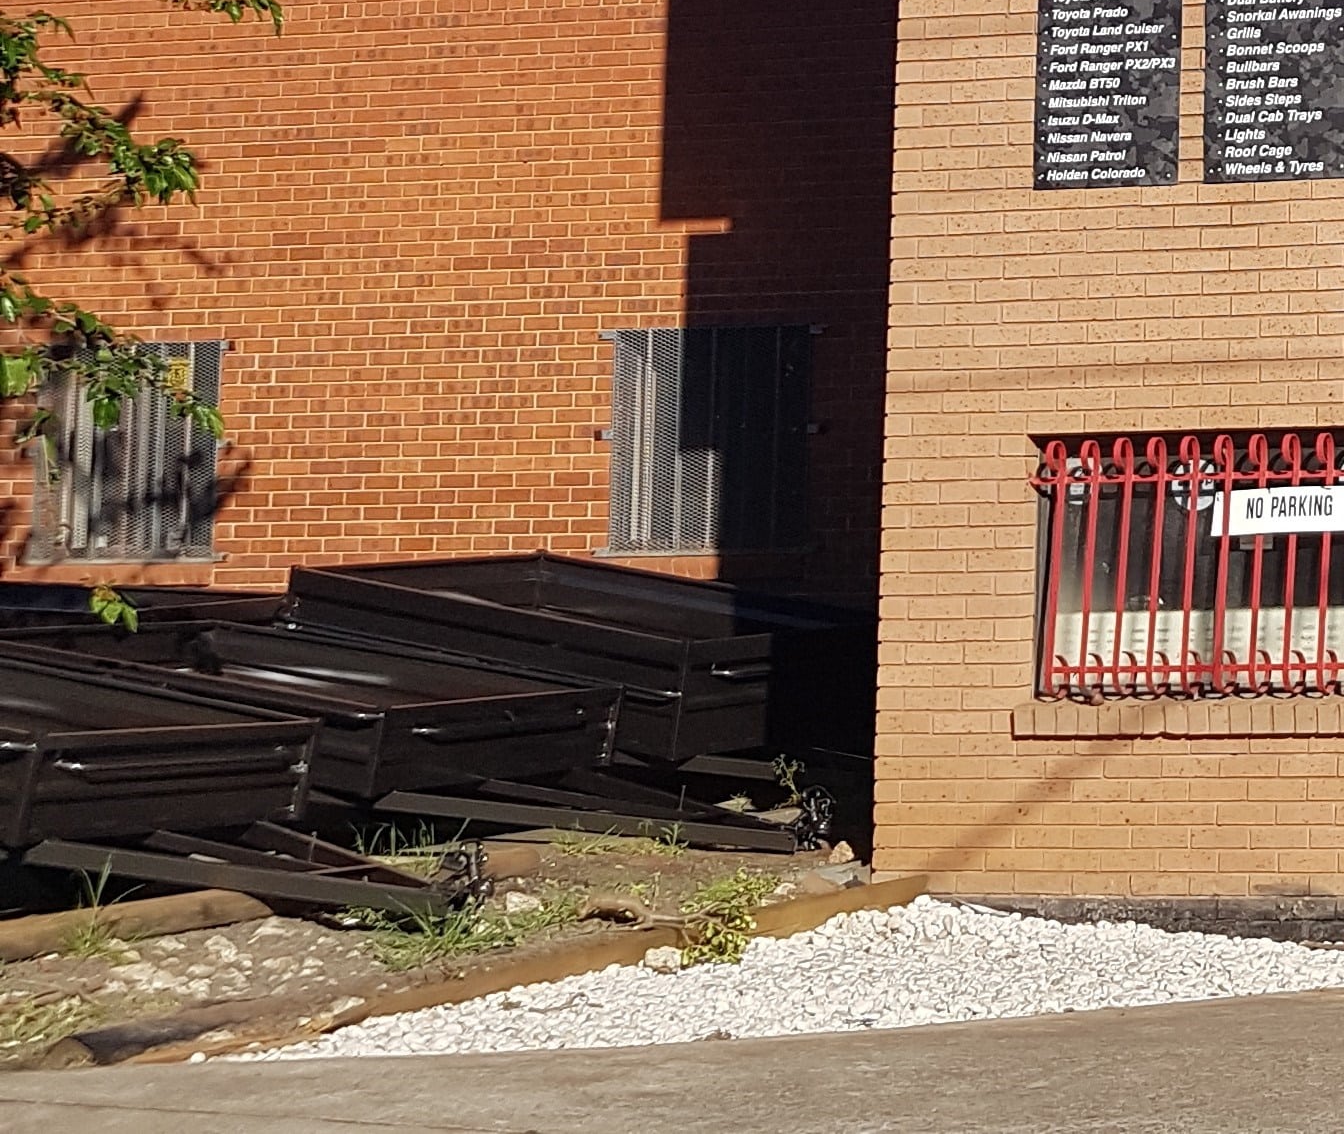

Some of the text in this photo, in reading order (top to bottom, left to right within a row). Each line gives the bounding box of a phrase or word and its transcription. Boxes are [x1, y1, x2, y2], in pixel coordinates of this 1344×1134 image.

[1052, 7, 1128, 22] Toyota Prado
[1278, 7, 1342, 21] Awanings
[1051, 26, 1090, 40] Toyota
[1093, 24, 1122, 36] Land
[1226, 27, 1261, 39] Grills
[1050, 41, 1149, 56] Ford Ranger PX1
[1226, 42, 1325, 56] Bonnet Scoops
[1049, 57, 1176, 74] Ford Ranger PX2/PX3
[1226, 60, 1280, 73] Bullbars
[1049, 77, 1120, 91] Mazda BT50
[1226, 76, 1298, 90] Brush Bars
[1048, 94, 1147, 108] Mitsubishi Triton
[1225, 93, 1302, 107] Sides Steps
[1048, 114, 1120, 126] Isuzu D-Max
[1225, 109, 1322, 123] Dual Cab Trays
[1047, 133, 1088, 144] Nissan
[1225, 128, 1266, 143] Lights
[1047, 150, 1126, 163] Nissan Patrol
[1225, 145, 1292, 159] Roof Cage
[1047, 167, 1146, 181] Holden Colorado
[1225, 160, 1324, 175] Wheels & Tyres
[1246, 495, 1333, 519] NO PARKING
